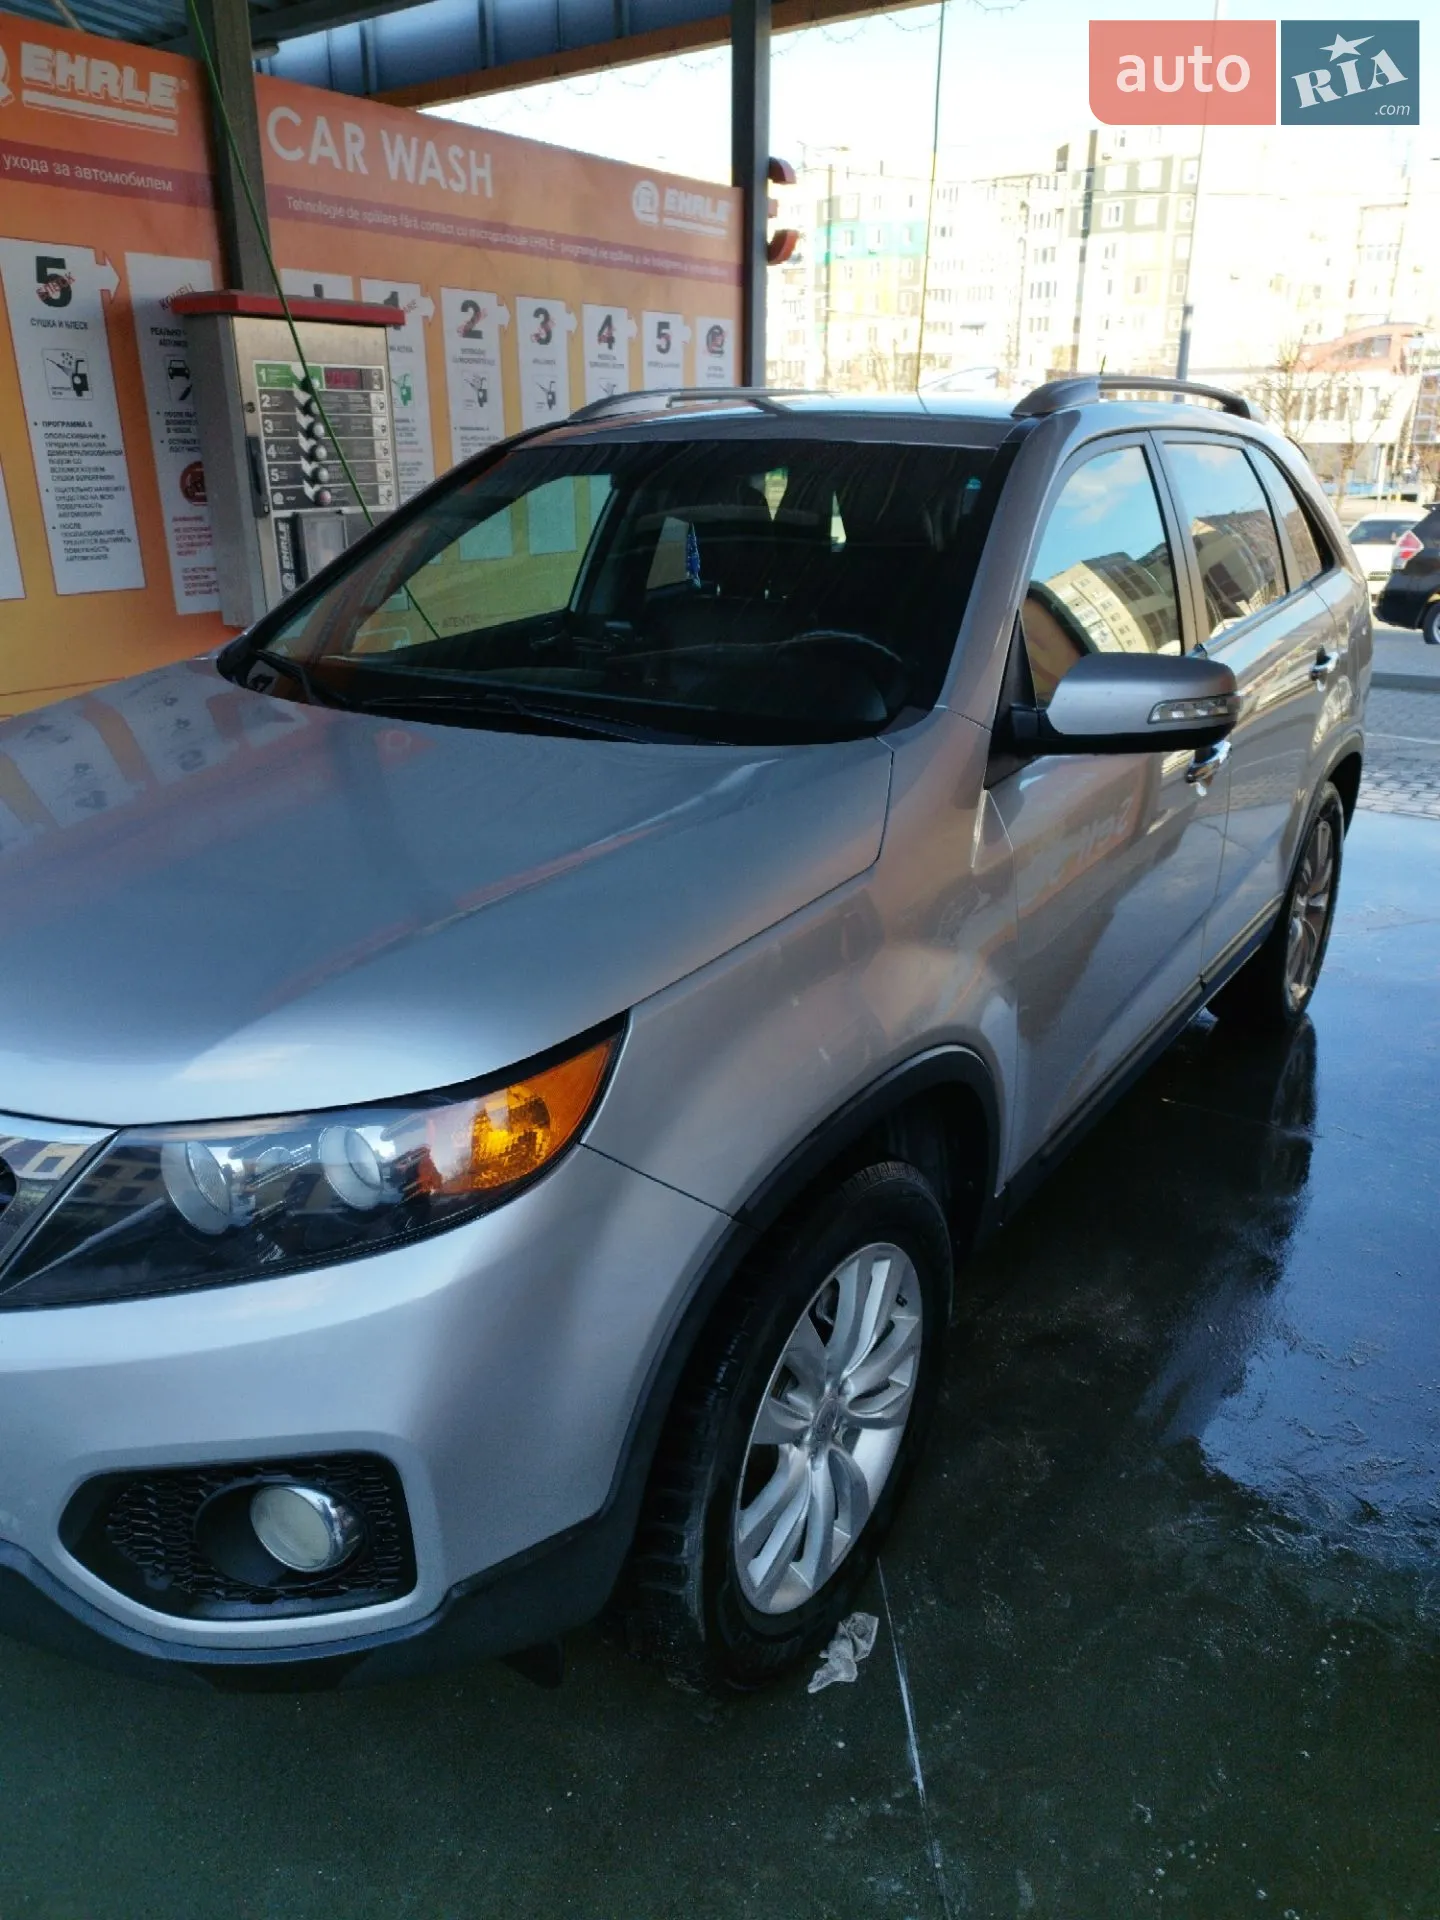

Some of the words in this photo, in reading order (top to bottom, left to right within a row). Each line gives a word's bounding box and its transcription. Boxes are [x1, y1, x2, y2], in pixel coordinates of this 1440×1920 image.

[20, 42, 178, 114] EHRLE
[266, 106, 369, 175] CAR
[380, 129, 494, 198] WASH
[3, 153, 49, 174] ухода
[52, 161, 70, 177] за
[75, 165, 174, 192] автомобилем
[285, 195, 345, 219] Tehnologie
[663, 187, 730, 223] EHRLE
[35, 256, 73, 308] 5
[460, 299, 484, 339] 2
[533, 307, 553, 346] 3
[598, 314, 616, 350] 4
[656, 321, 672, 354] 5
[258, 368, 268, 383] 1
[260, 394, 272, 408] 2
[264, 419, 275, 434] 3
[267, 444, 278, 459] 4
[270, 468, 280, 482] 5
